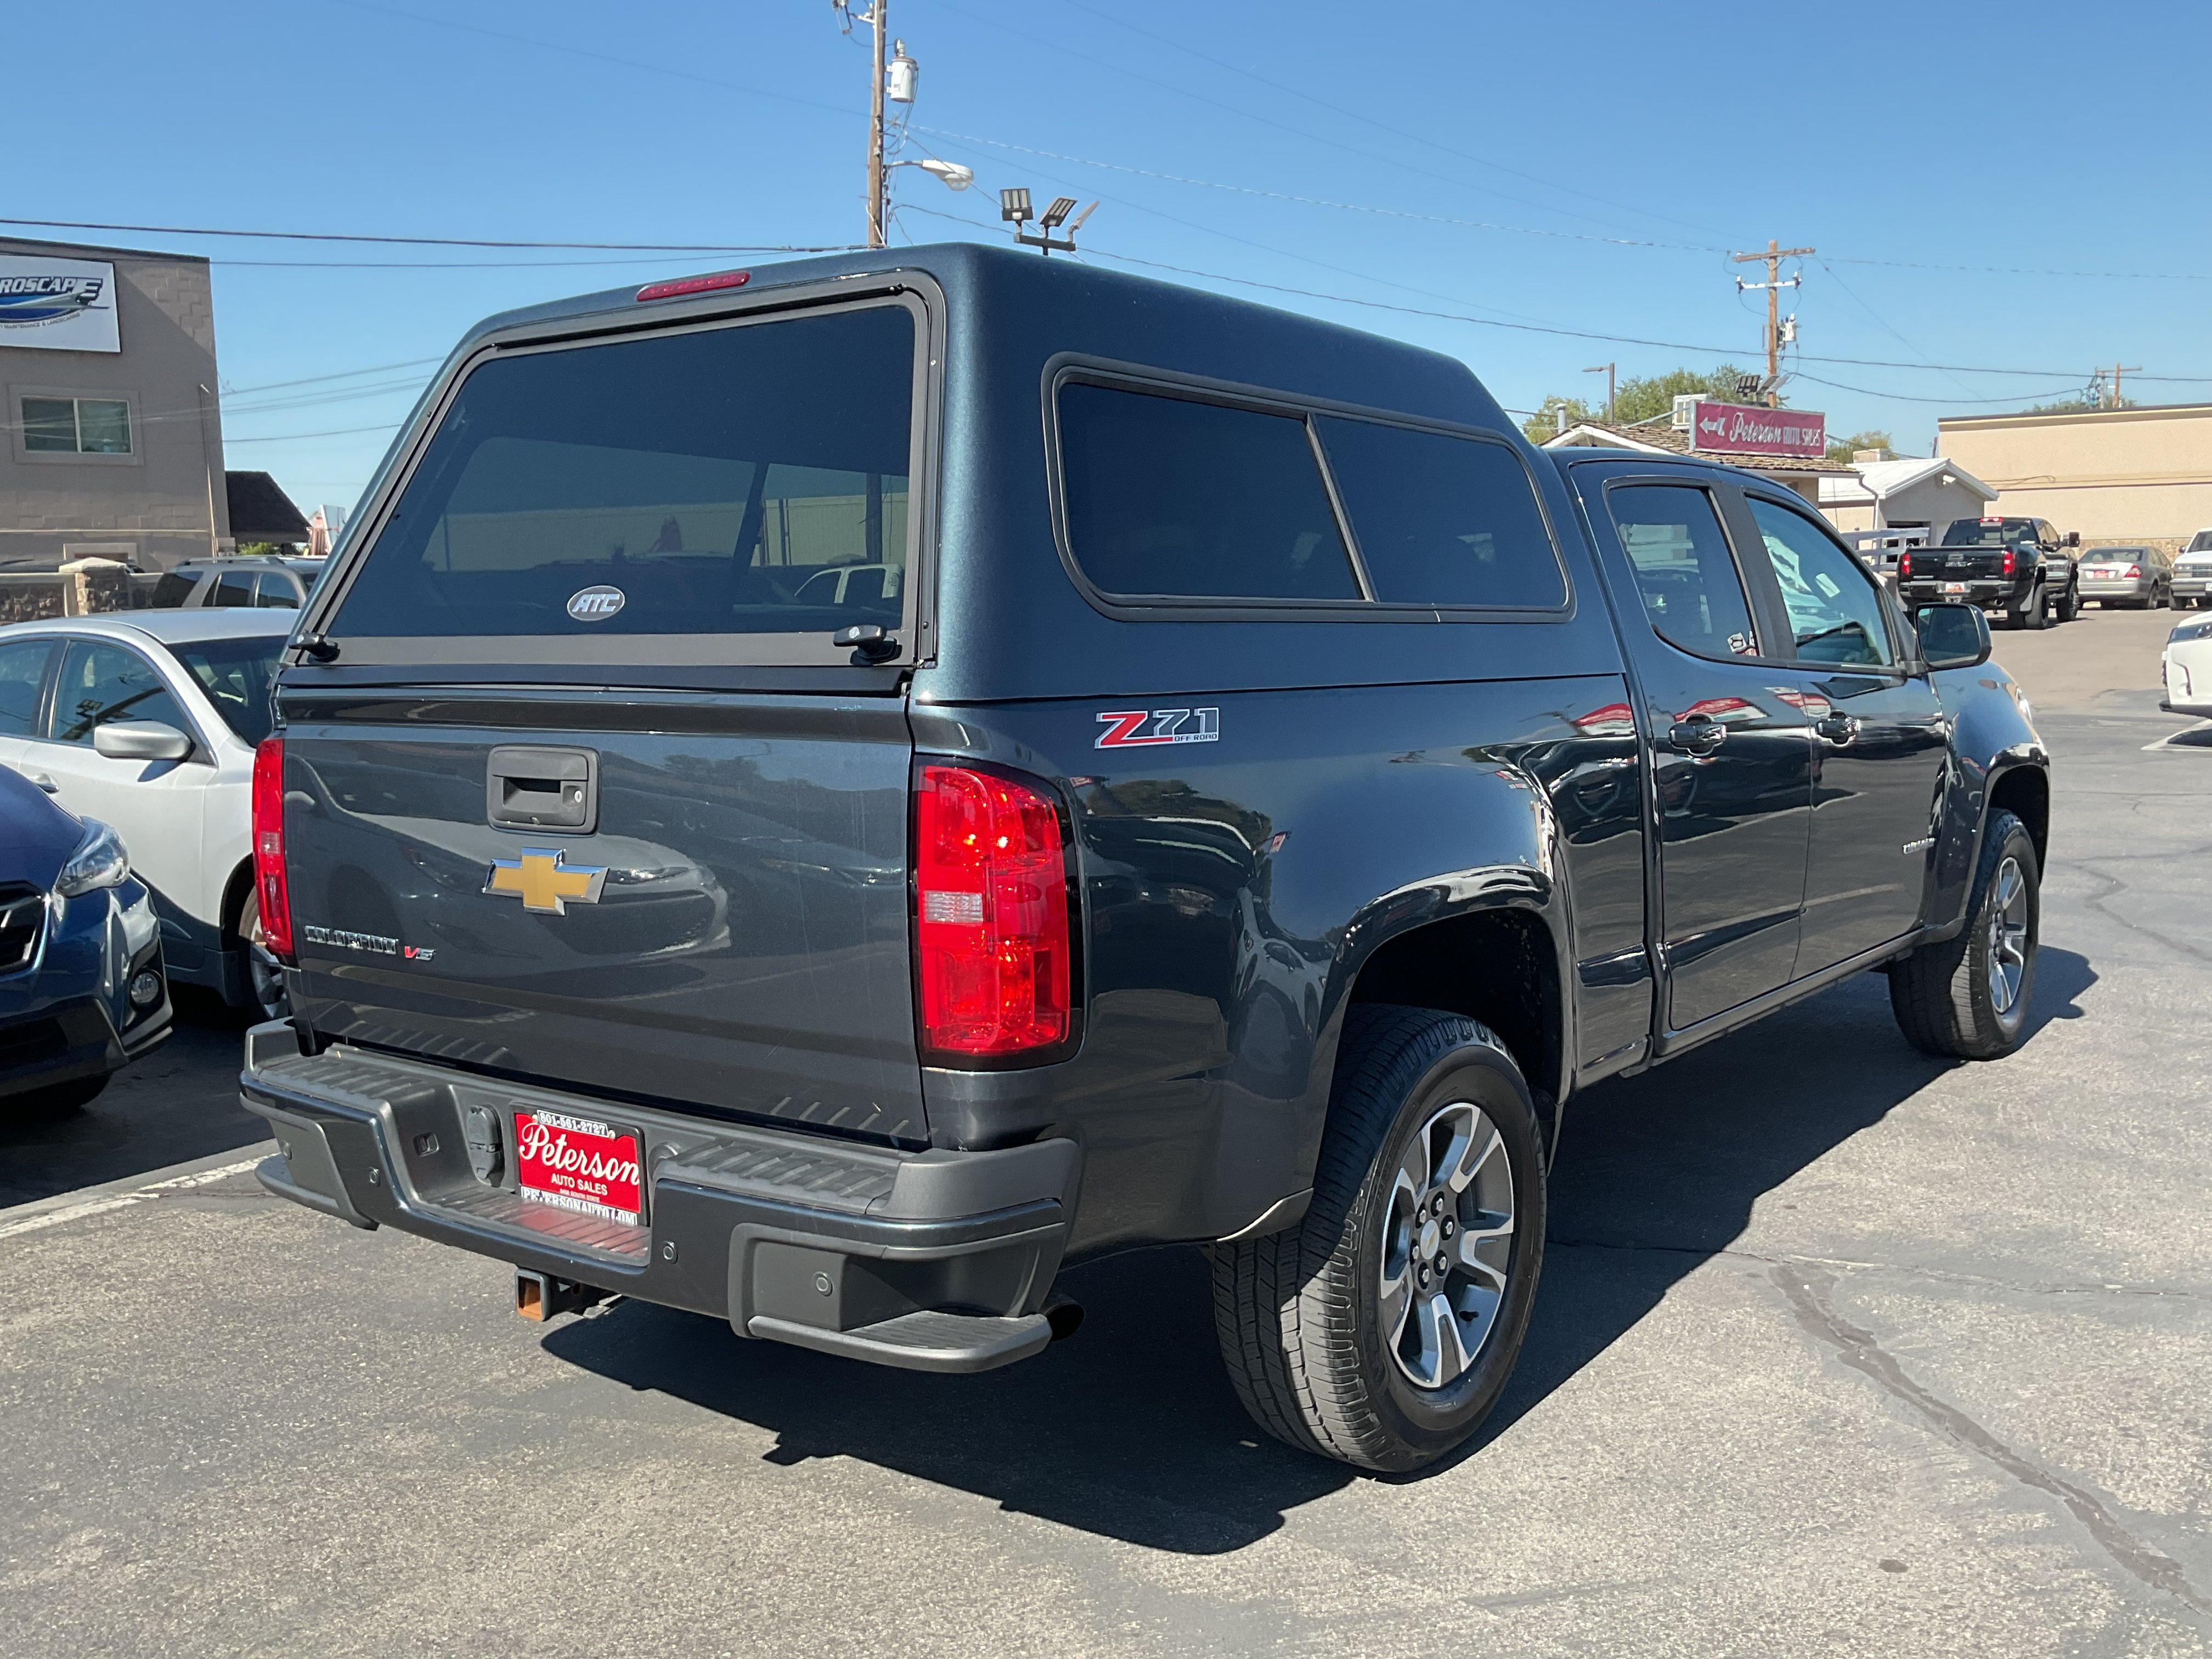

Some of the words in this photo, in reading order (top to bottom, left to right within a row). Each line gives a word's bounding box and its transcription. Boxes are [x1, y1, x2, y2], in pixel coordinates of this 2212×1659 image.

[1729, 412, 1781, 443] Peterson
[1783, 426, 1800, 445] AUTO
[1802, 428, 1820, 447] SALES
[572, 594, 620, 612] ATC
[1094, 707, 1218, 748] Z71
[304, 926, 397, 955] COLORADO
[539, 1112, 606, 1135] 801-561-2727
[519, 1122, 640, 1186] Peterson
[551, 1173, 575, 1188] AUTO
[577, 1179, 608, 1195] SALES
